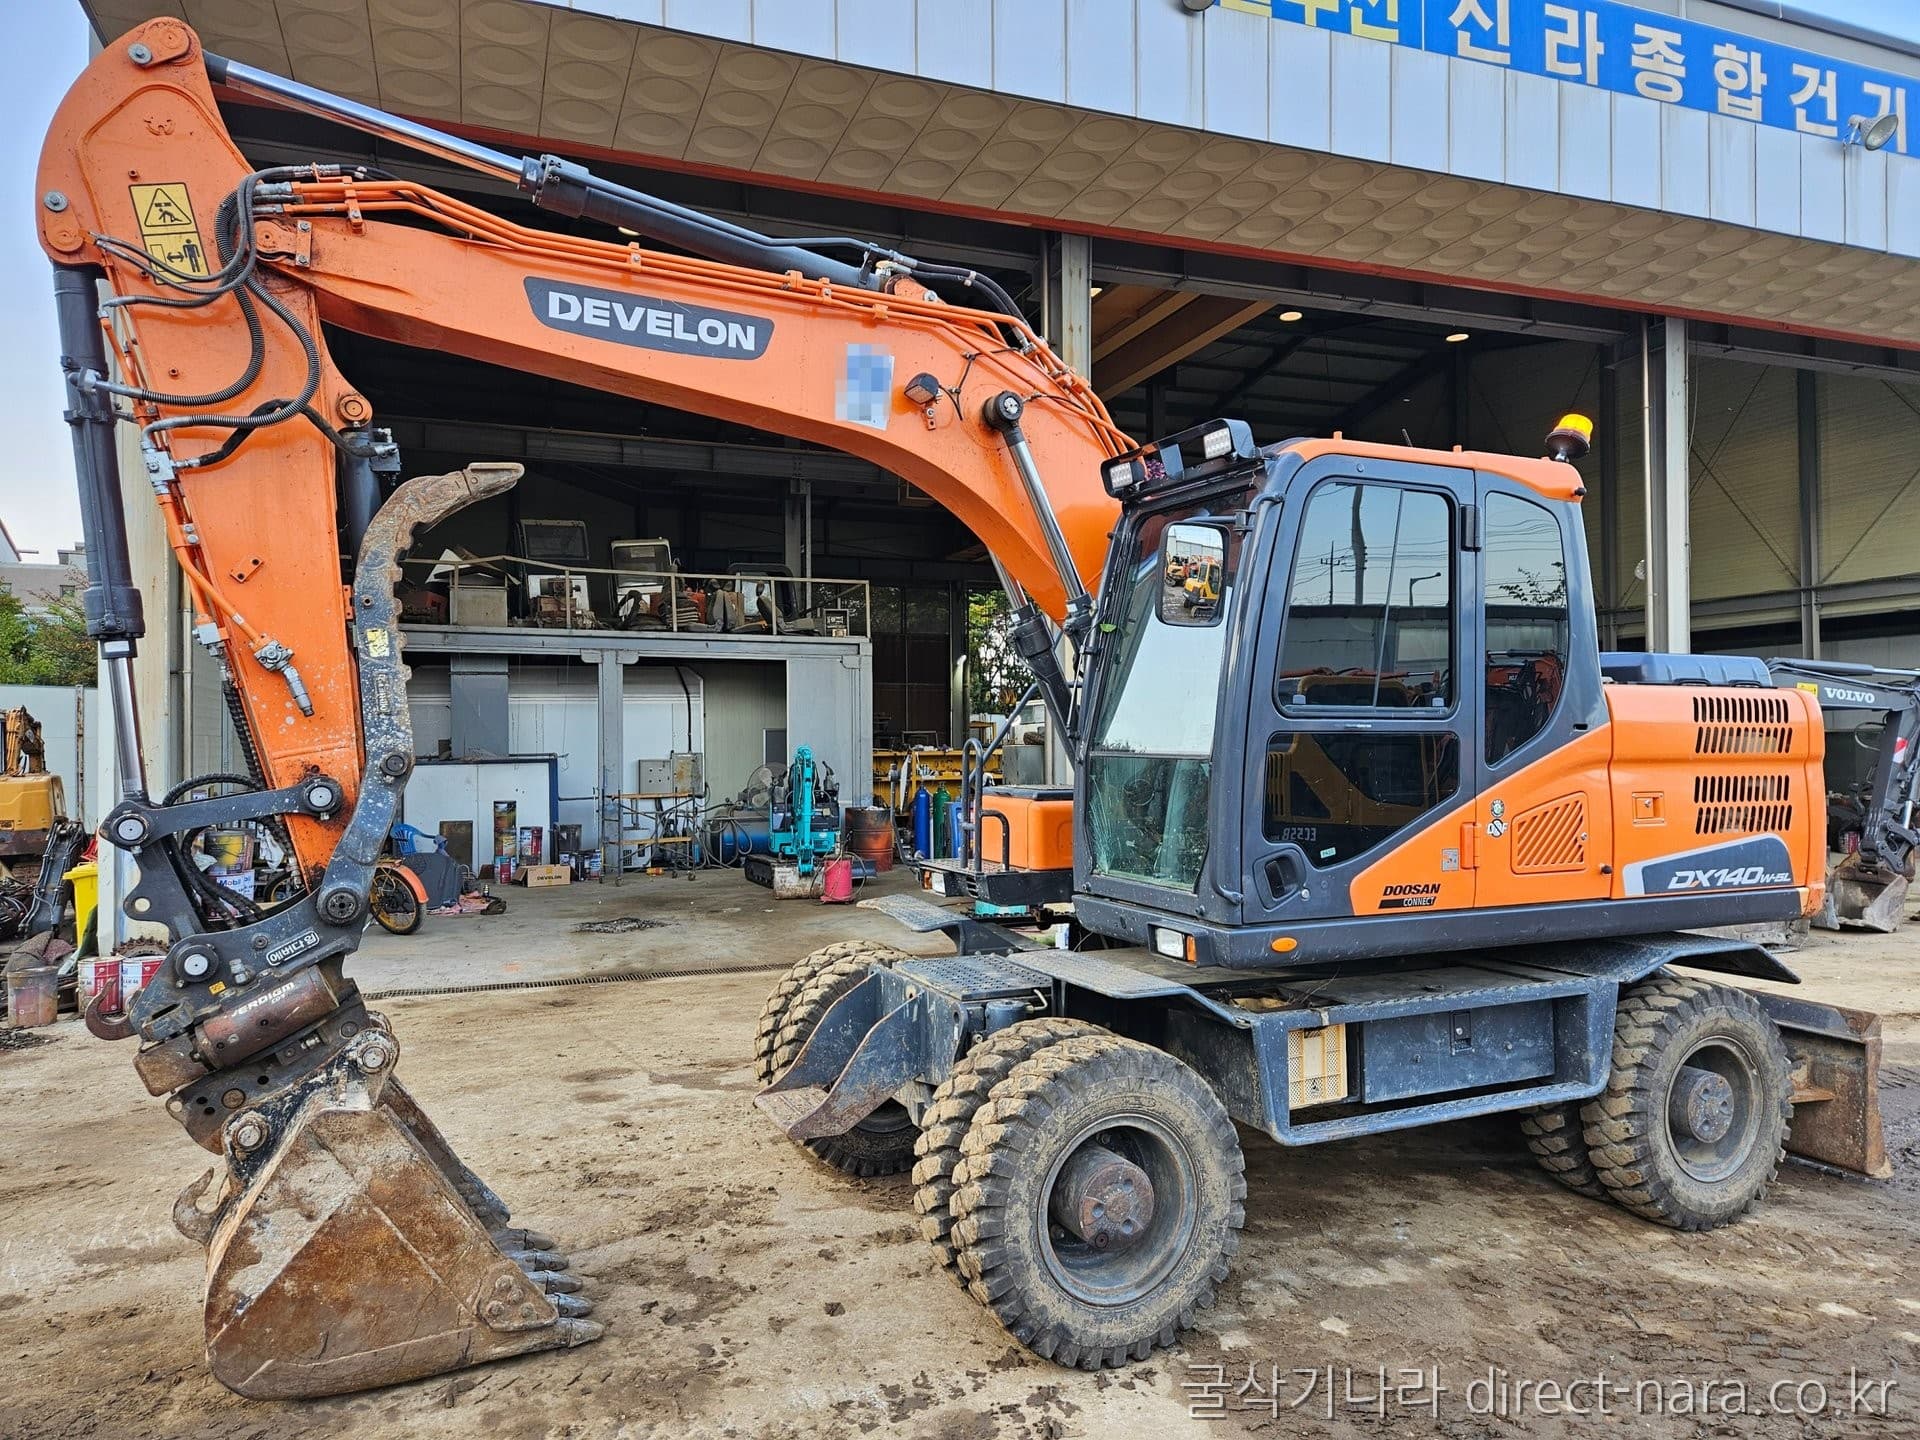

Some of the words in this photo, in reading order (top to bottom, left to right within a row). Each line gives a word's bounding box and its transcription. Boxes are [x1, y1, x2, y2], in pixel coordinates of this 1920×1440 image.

[548, 291, 756, 352] DEVELON
[1824, 687, 1876, 704] VOLVO
[1382, 883, 1441, 896] DOOSAN
[1403, 896, 1436, 907] CONNECT
[269, 932, 317, 963] 에버다임
